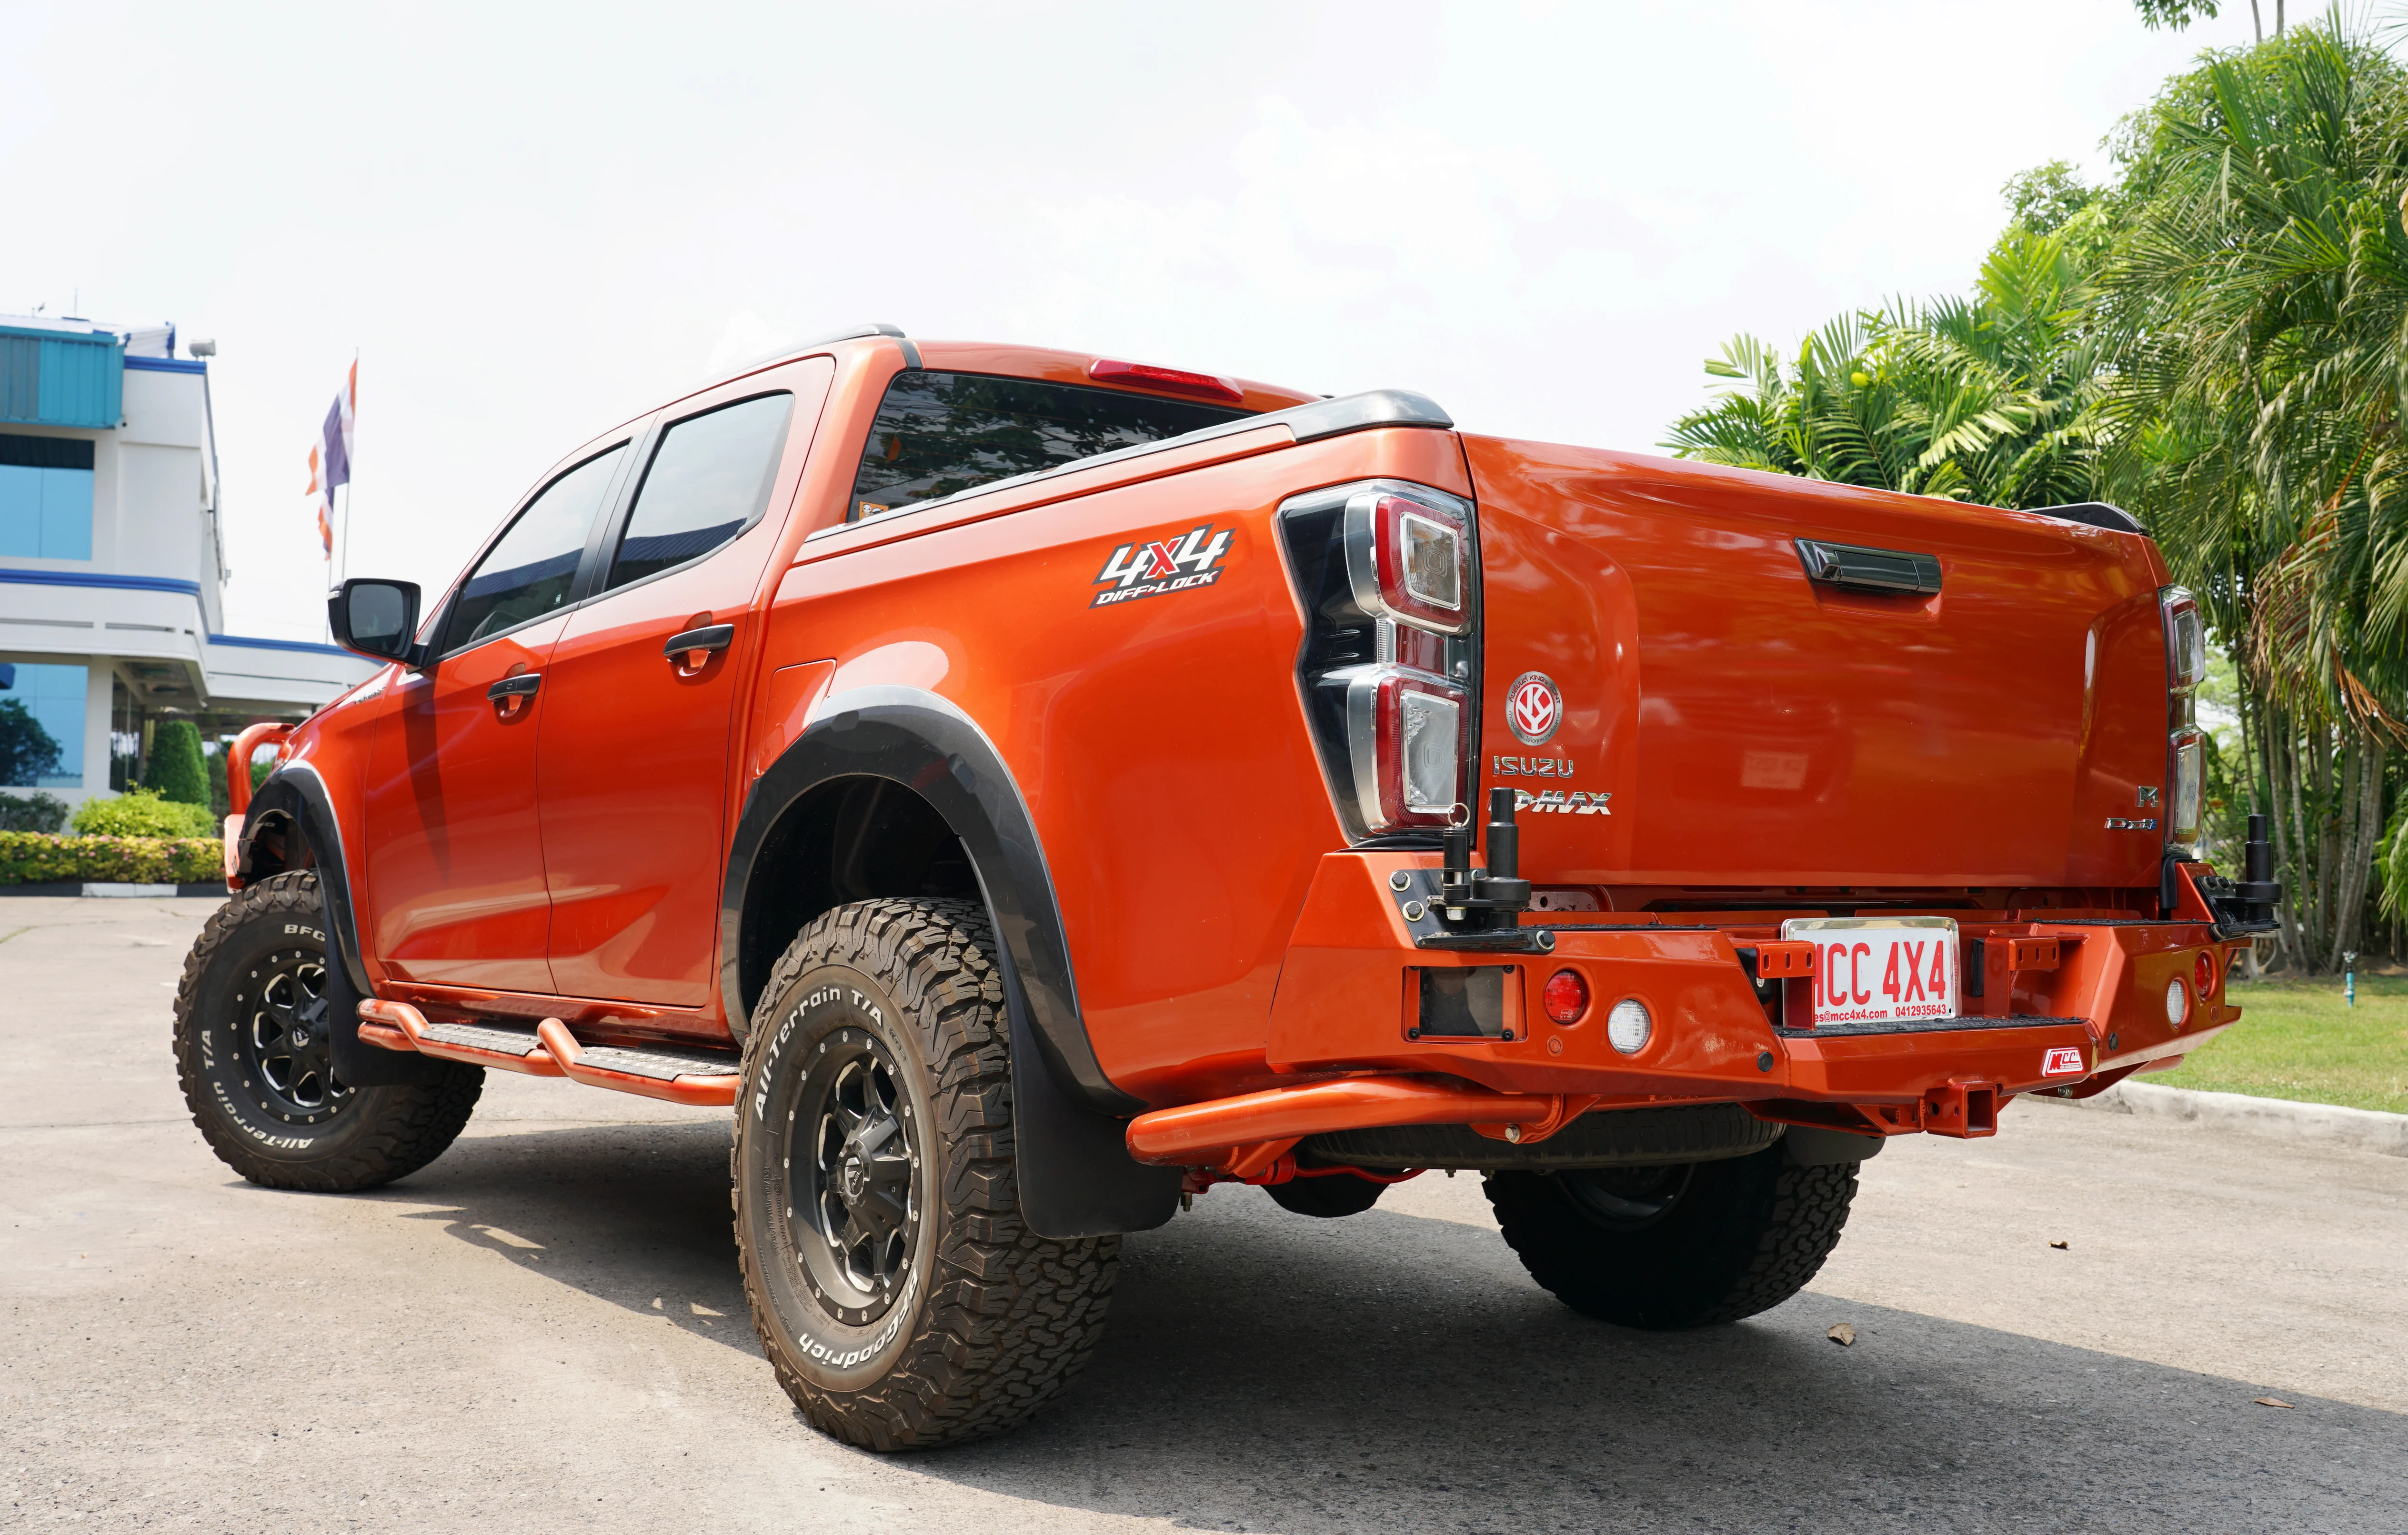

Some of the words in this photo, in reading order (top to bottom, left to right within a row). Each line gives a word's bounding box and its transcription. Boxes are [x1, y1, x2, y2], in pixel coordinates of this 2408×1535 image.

[1529, 674, 1548, 685] KING's
[1550, 683, 1561, 704] YONT
[1493, 755, 1574, 778] ISUZU
[1882, 940, 1946, 1003] 4X4
[1815, 1008, 1888, 1023] es@mcc4x4.com
[1895, 1004, 1946, 1017] 0412935643
[754, 986, 841, 1121] All-Terrain
[851, 1170, 863, 1192] FUEL
[799, 1266, 918, 1369] BFGoodrich
